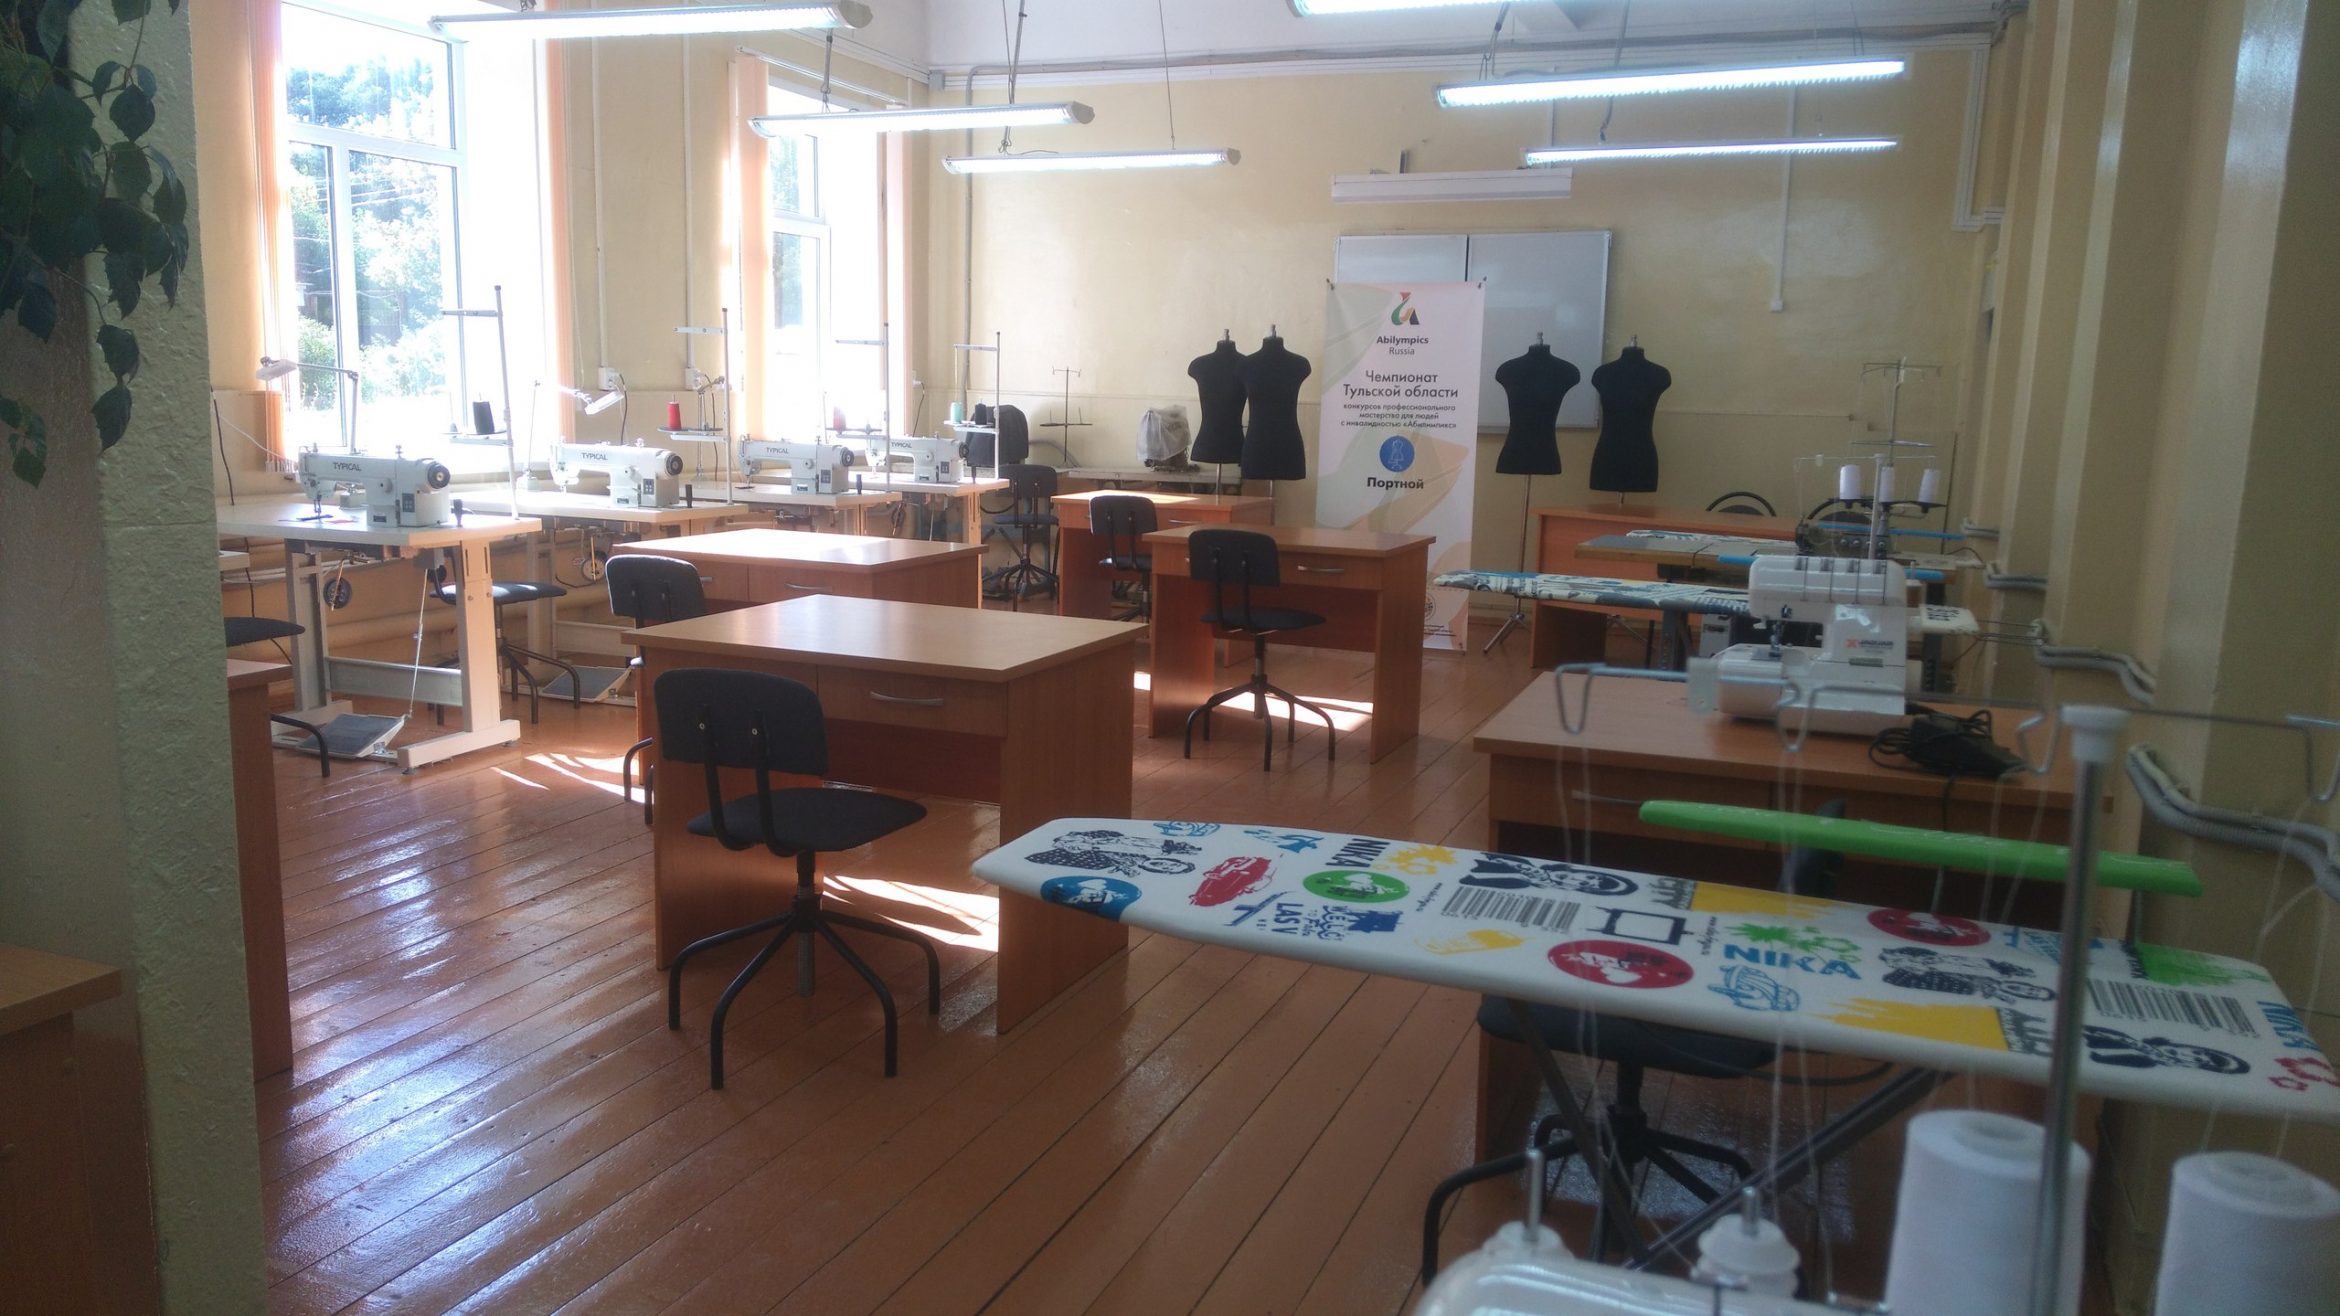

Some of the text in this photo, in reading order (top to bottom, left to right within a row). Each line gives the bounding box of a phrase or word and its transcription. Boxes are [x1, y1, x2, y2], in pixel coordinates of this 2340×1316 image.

[1376, 336, 1429, 346] Abilympics
[1388, 347, 1415, 356] Russia
[1365, 370, 1438, 383] Чемпионат
[1343, 384, 1459, 400] Тульской области
[581, 452, 608, 461] TYPICAL
[766, 447, 789, 455] TYPICAL
[333, 462, 362, 471] TYPICAL
[1366, 476, 1424, 490] Портной
[1325, 838, 1391, 868] NIKA
[1273, 903, 1304, 924] LAS
[1723, 943, 1862, 980] NIKA
